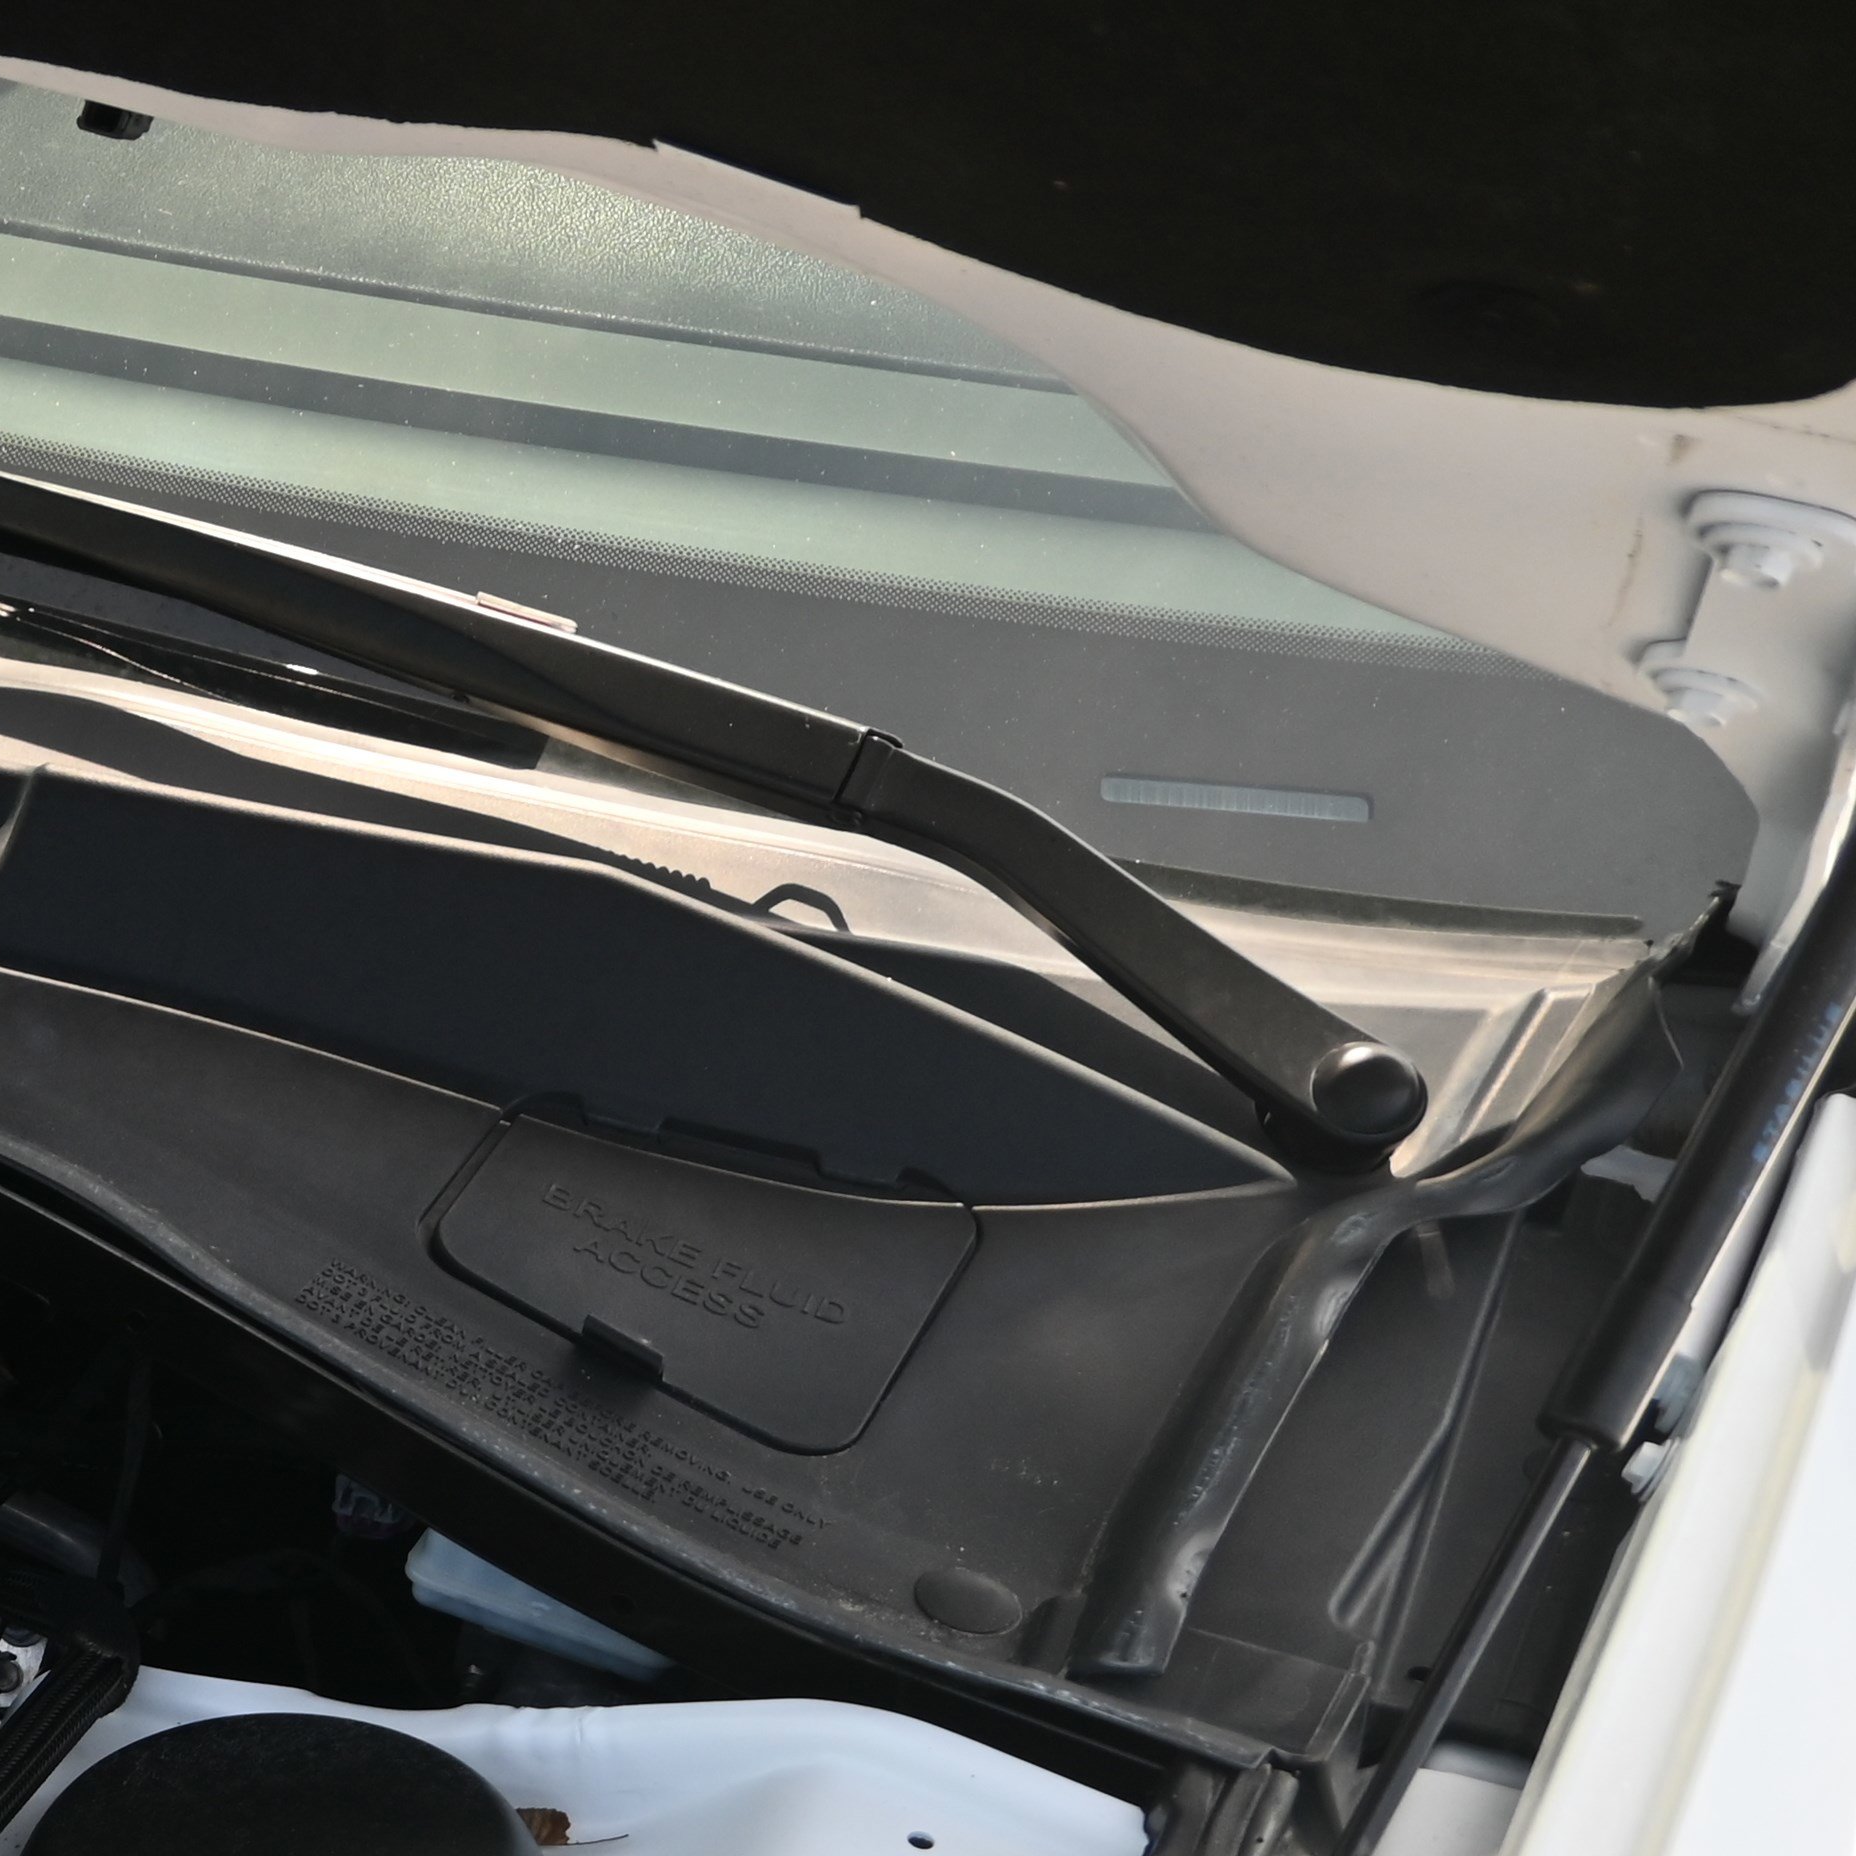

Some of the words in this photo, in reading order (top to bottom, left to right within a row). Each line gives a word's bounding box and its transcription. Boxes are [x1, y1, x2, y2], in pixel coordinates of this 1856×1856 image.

[542, 1183, 702, 1269] BRAKE
[711, 1258, 846, 1325] FLUID
[573, 1241, 765, 1329] ACCESS
[294, 1293, 331, 1315] DOT
[330, 1313, 343, 1324] 3
[343, 1323, 444, 1379] PROVENANT
[301, 1286, 360, 1318] AVANT
[359, 1317, 385, 1334] DE
[320, 1267, 357, 1289] DOT
[356, 1286, 369, 1297] 3
[369, 1295, 417, 1324] FLUID
[419, 1322, 466, 1352] FROM
[468, 1351, 479, 1361] A
[353, 1299, 372, 1316] EN
[448, 1353, 535, 1405] NETTOYER
[412, 1303, 466, 1340] CLEAN
[741, 1484, 778, 1506] USE
[780, 1502, 831, 1529] ONLY
